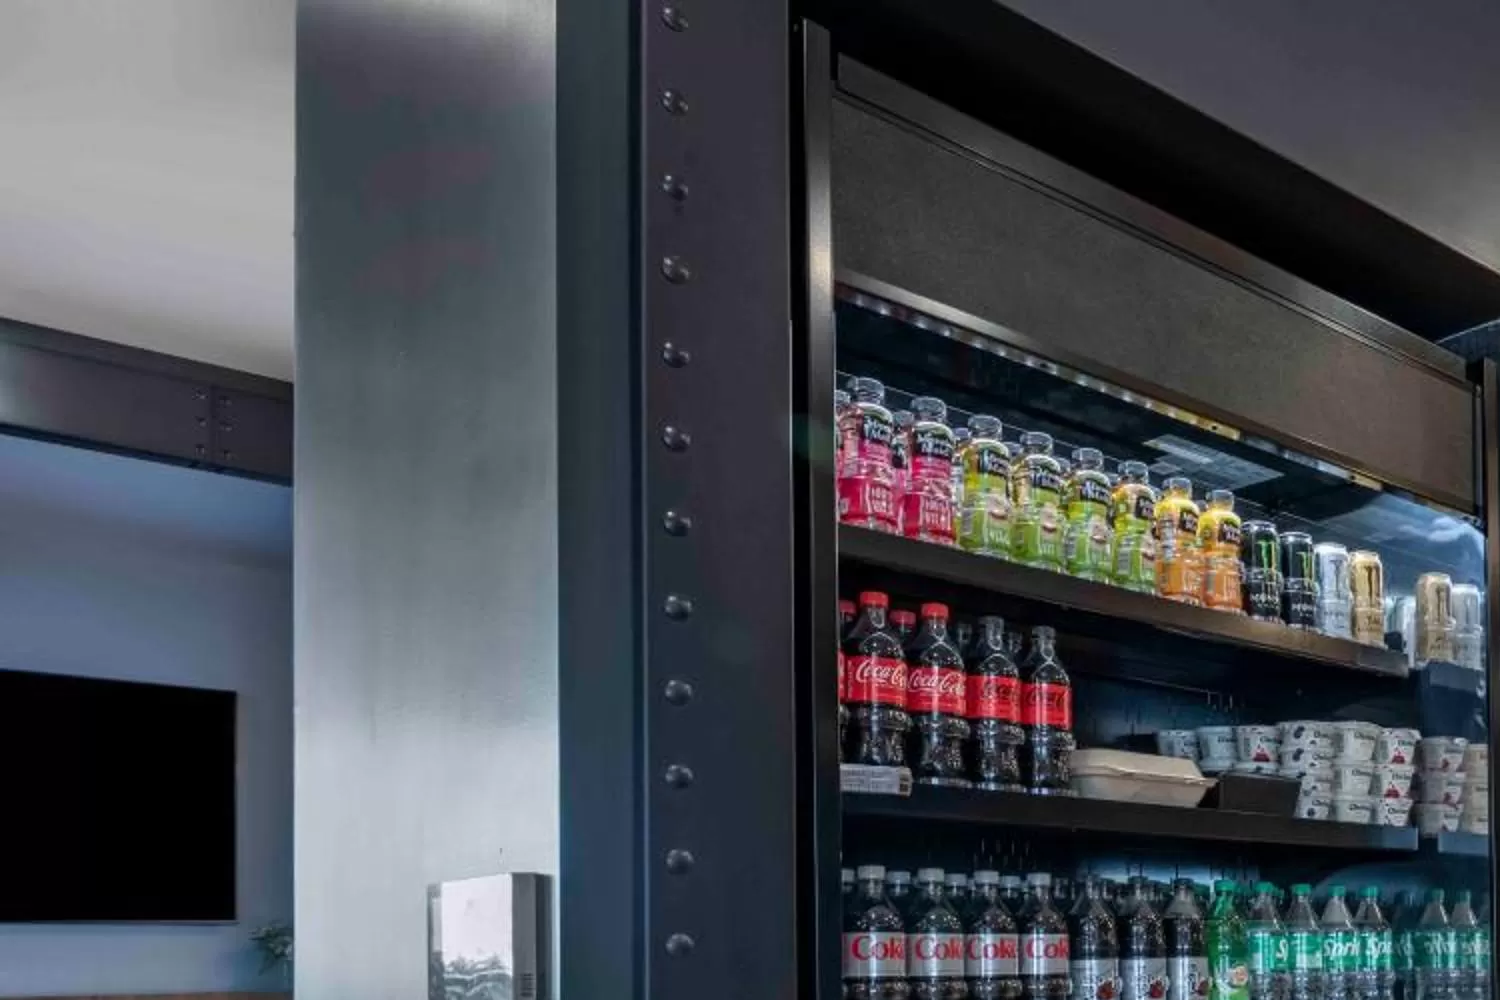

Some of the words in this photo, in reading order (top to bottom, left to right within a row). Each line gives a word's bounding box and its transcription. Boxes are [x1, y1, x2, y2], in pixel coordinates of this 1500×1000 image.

[852, 934, 905, 960] Cok
[915, 934, 964, 960] Cok
[967, 935, 1017, 960] Cok
[1023, 935, 1069, 960] Cok
